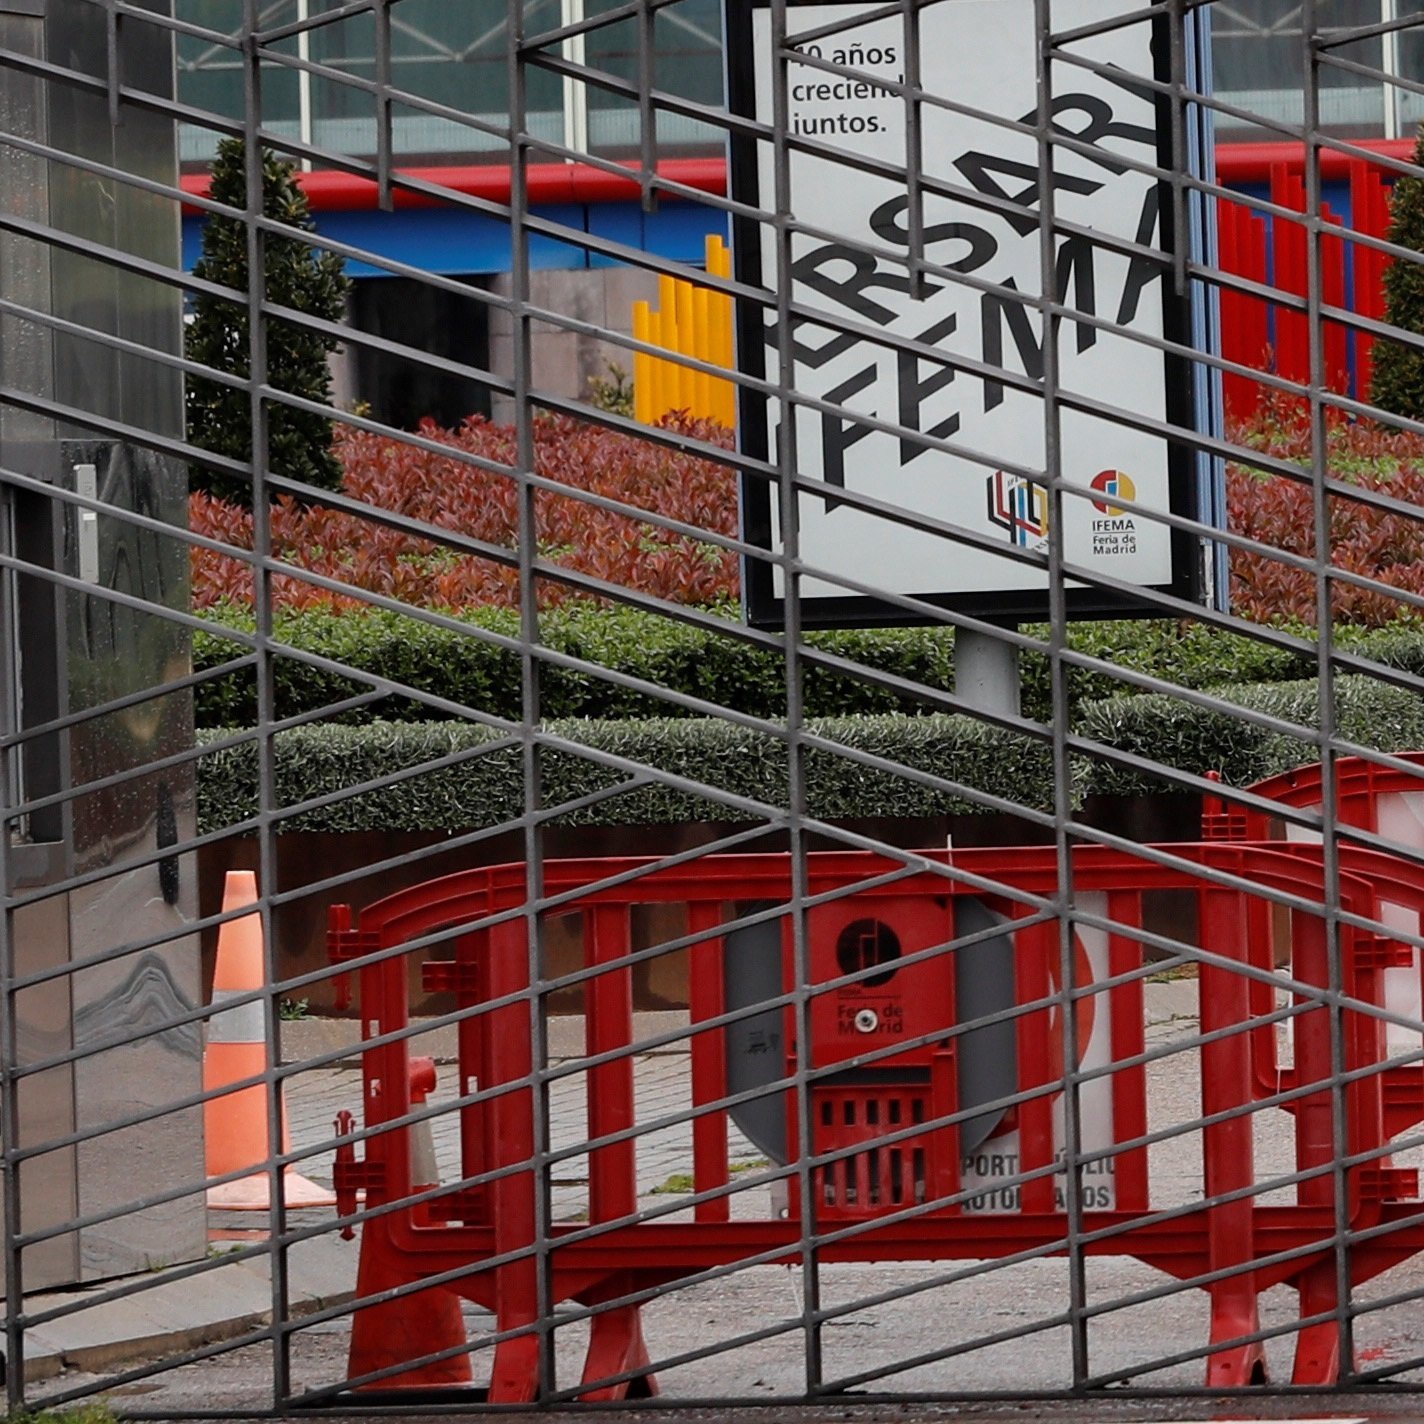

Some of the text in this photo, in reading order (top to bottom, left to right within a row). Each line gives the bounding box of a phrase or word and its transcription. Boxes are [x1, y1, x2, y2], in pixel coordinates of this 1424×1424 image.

[832, 43, 896, 65] años
[1092, 519, 1135, 532] IFEMA
[1093, 534, 1136, 545] Feria de
[1093, 544, 1137, 555] Madrid
